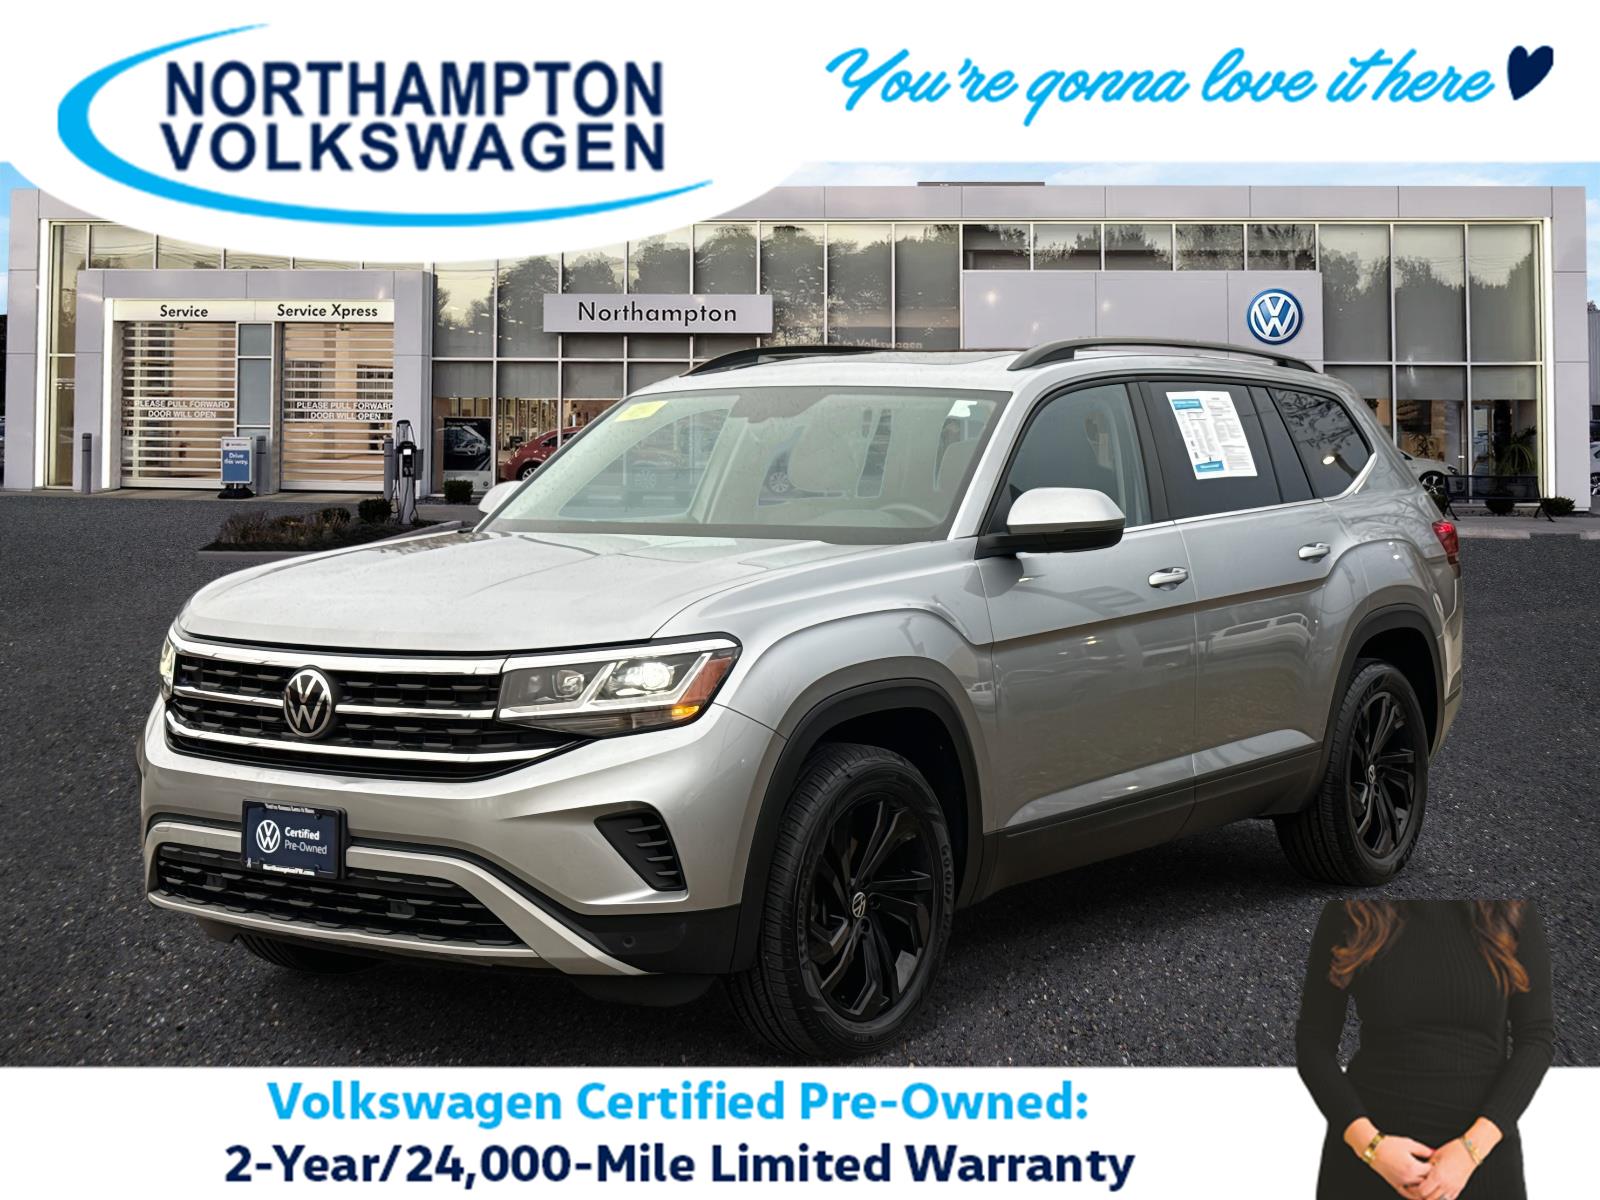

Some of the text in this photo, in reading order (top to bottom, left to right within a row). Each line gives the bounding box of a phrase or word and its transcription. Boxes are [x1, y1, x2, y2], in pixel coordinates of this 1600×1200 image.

[160, 304, 209, 318] Service
[276, 303, 378, 319] Service Xpress
[578, 301, 738, 327] Northampton
[134, 400, 230, 409] PLEASE PULL FORWARD
[296, 401, 395, 410] PLEASE PULL FORWARD
[148, 410, 171, 418] DOOR
[310, 412, 381, 420] DOOR WILL OPEN
[284, 826, 320, 841] Certified
[284, 840, 328, 855] Pre-Owned
